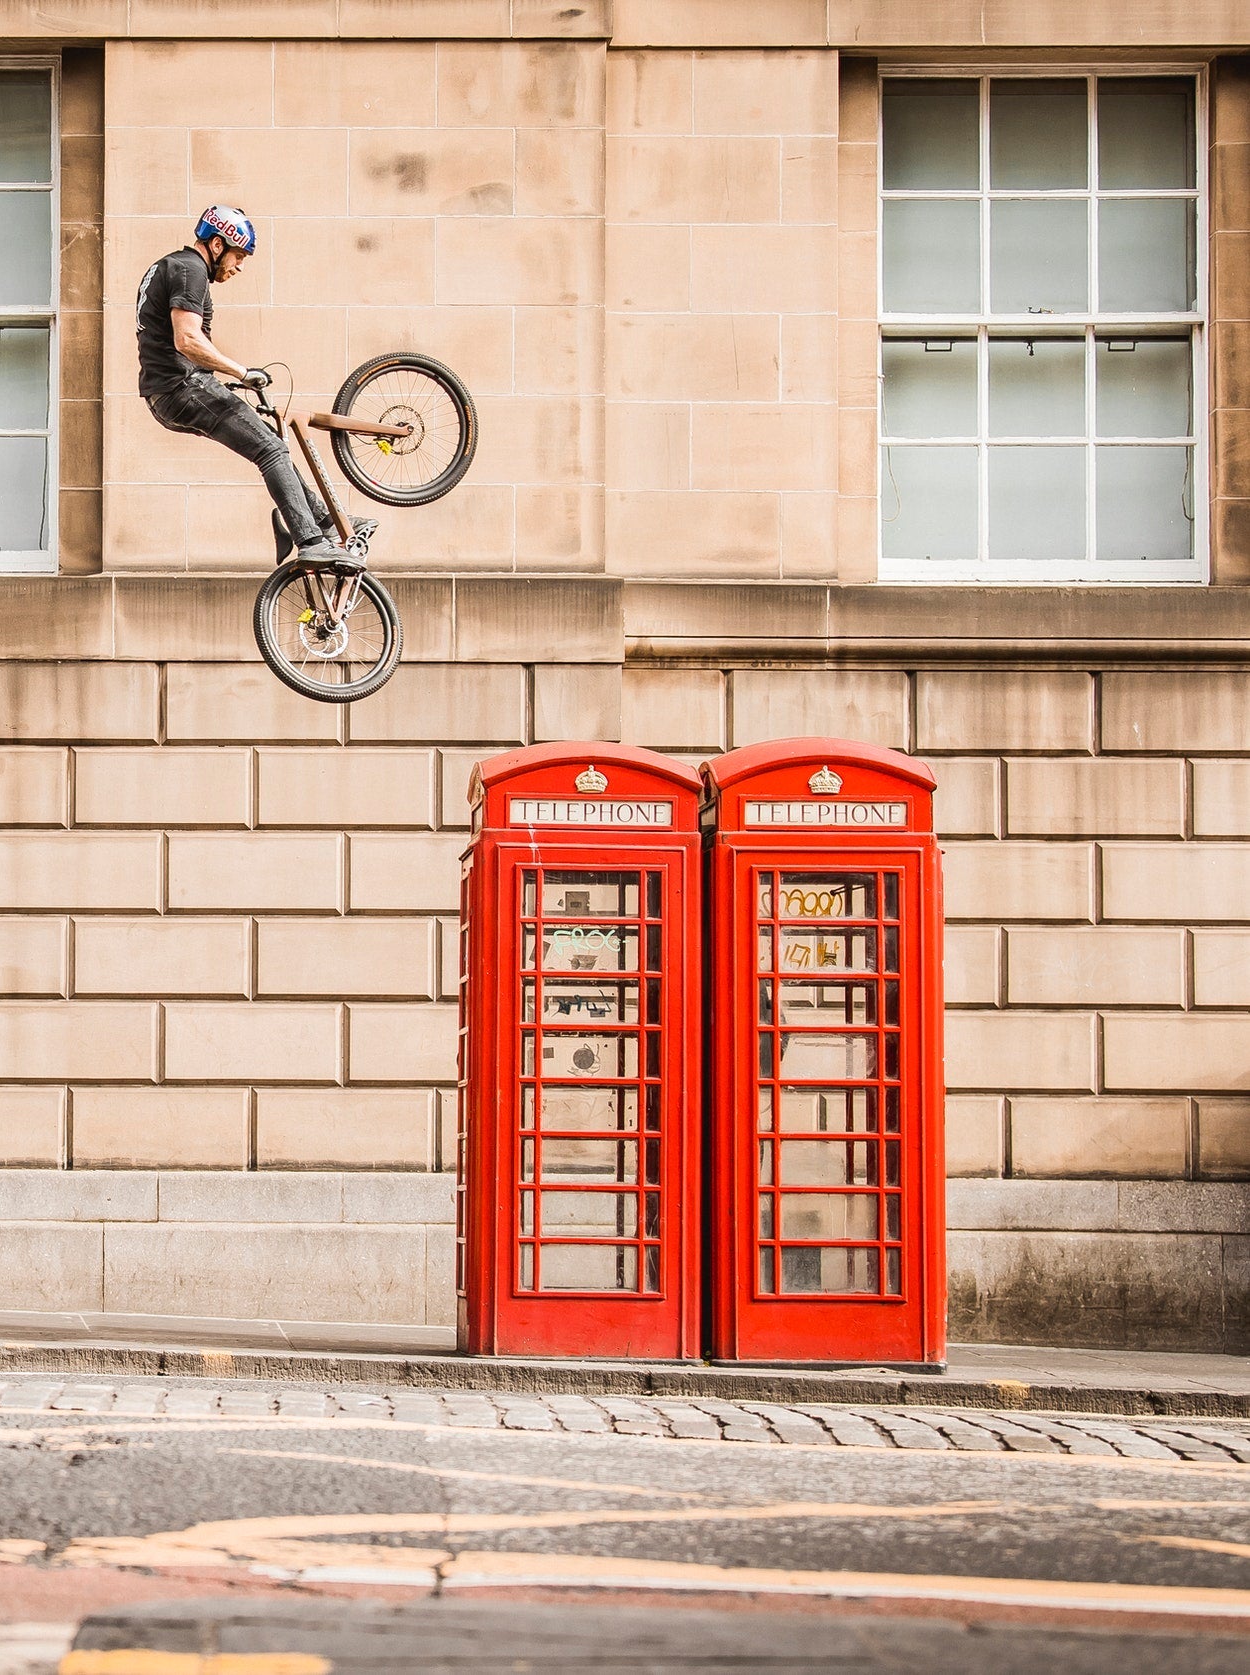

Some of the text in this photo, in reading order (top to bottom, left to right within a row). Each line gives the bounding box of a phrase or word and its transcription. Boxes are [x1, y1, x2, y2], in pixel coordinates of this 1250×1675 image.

[203, 210, 249, 247] Red Bull
[518, 801, 666, 824] TELEPHONE
[752, 802, 901, 824] TELEPHONE
